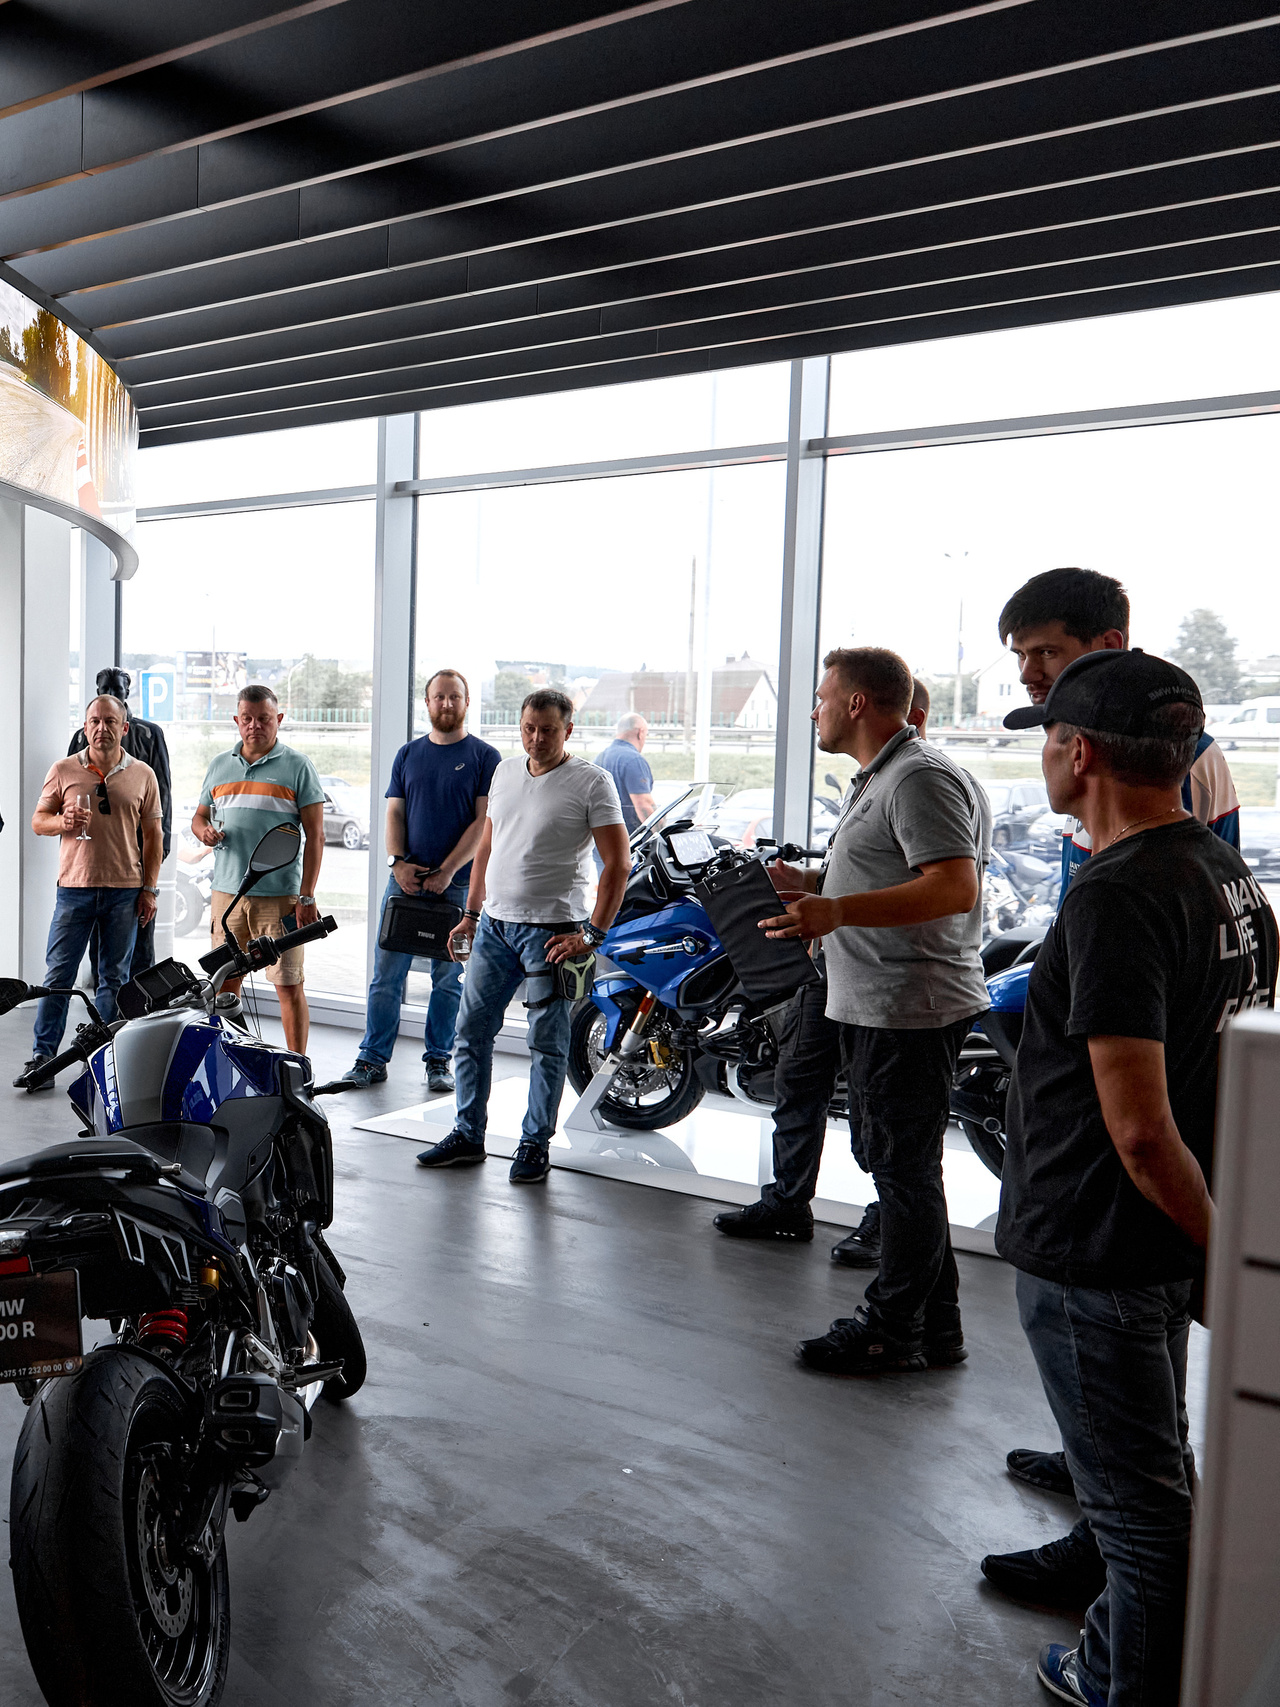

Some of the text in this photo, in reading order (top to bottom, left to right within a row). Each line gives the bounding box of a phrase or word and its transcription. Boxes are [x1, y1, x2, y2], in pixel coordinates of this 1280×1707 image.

[148, 676, 168, 717] P
[1222, 874, 1270, 917] MAK
[417, 931, 436, 940] THULE
[1219, 915, 1259, 961] LIFE
[22, 1321, 36, 1338] R
[0, 1369, 17, 1379] +375
[18, 1368, 27, 1376] 17
[28, 1366, 41, 1375] 232
[42, 1365, 52, 1373] 00
[53, 1363, 62, 1372] 00
